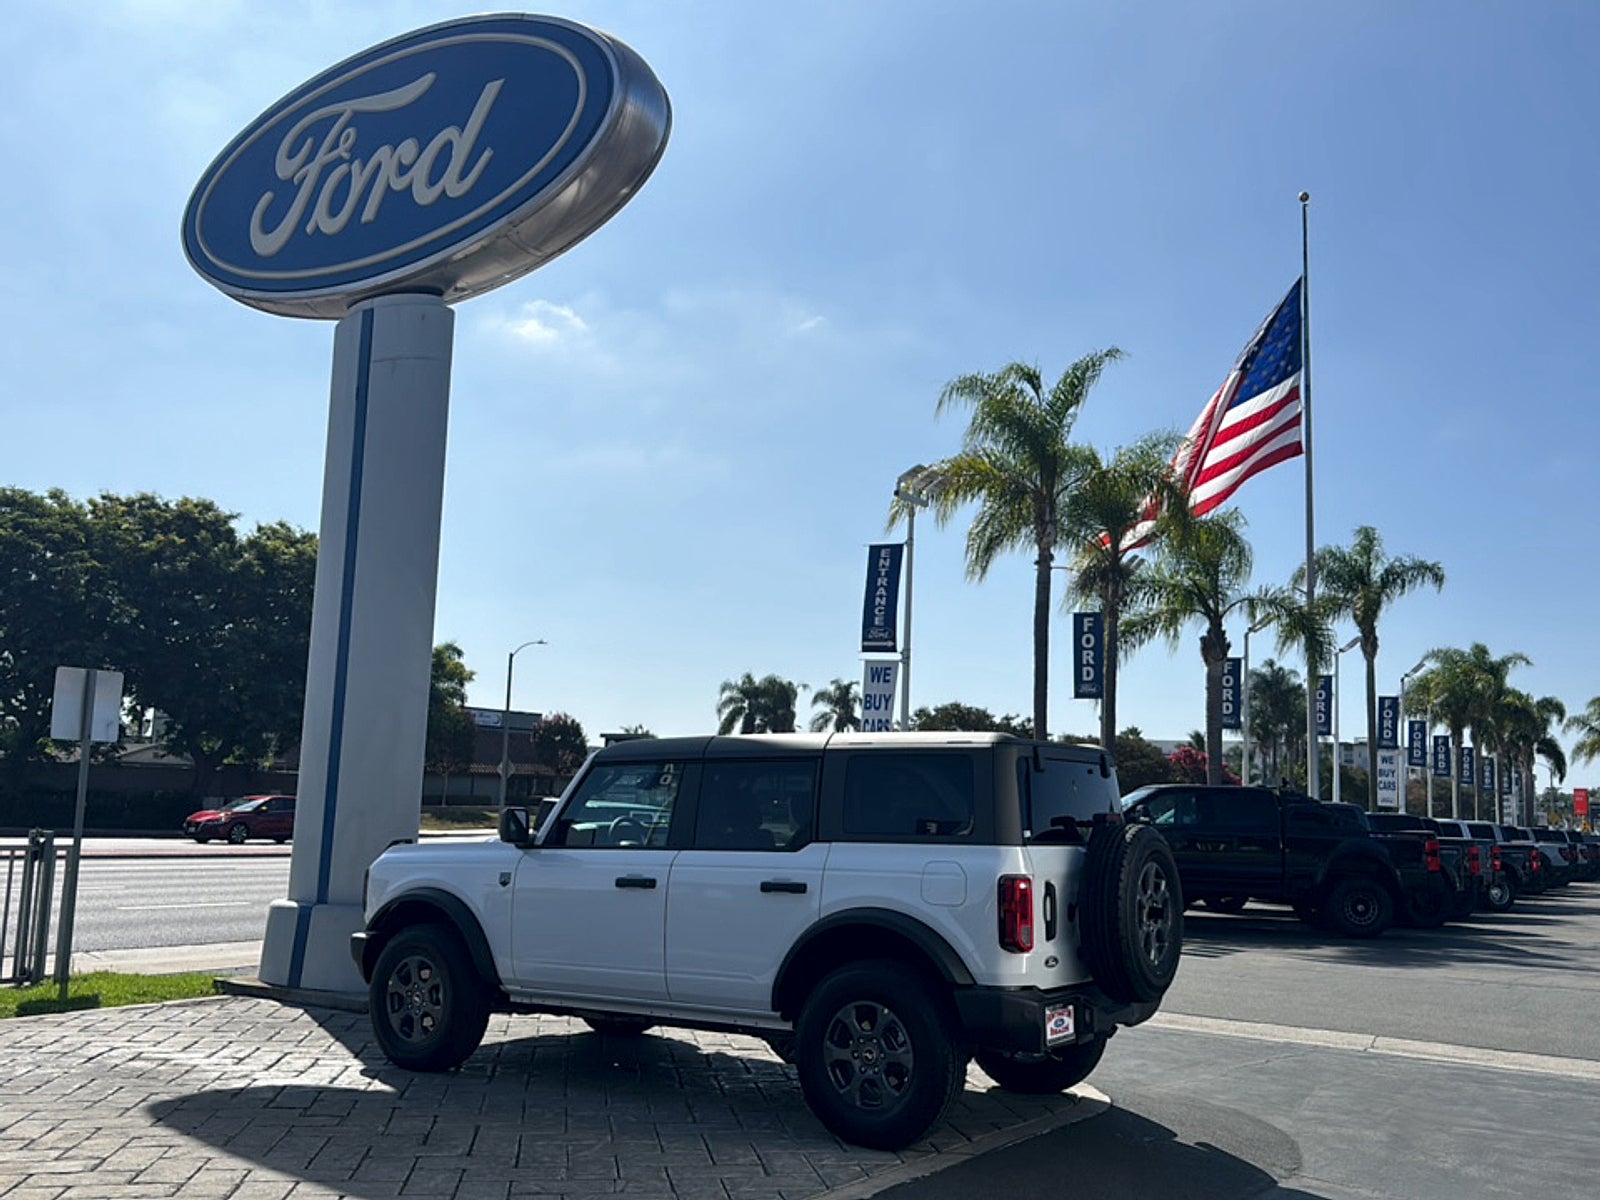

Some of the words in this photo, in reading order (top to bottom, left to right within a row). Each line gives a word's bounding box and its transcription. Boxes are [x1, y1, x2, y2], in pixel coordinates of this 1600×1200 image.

[249, 71, 505, 257] Ford
[874, 548, 891, 626] ENTRANCE
[1081, 616, 1095, 682] FORD
[870, 666, 892, 683] WE
[1222, 661, 1234, 715] FORD
[864, 693, 892, 711] BUY
[1316, 678, 1327, 723] FORD
[863, 718, 890, 732] CARS
[1383, 699, 1393, 739] FORD
[1413, 723, 1422, 758] FORD
[1378, 768, 1396, 778] BUY
[1381, 755, 1394, 765] WE
[1378, 780, 1396, 791] CARS
